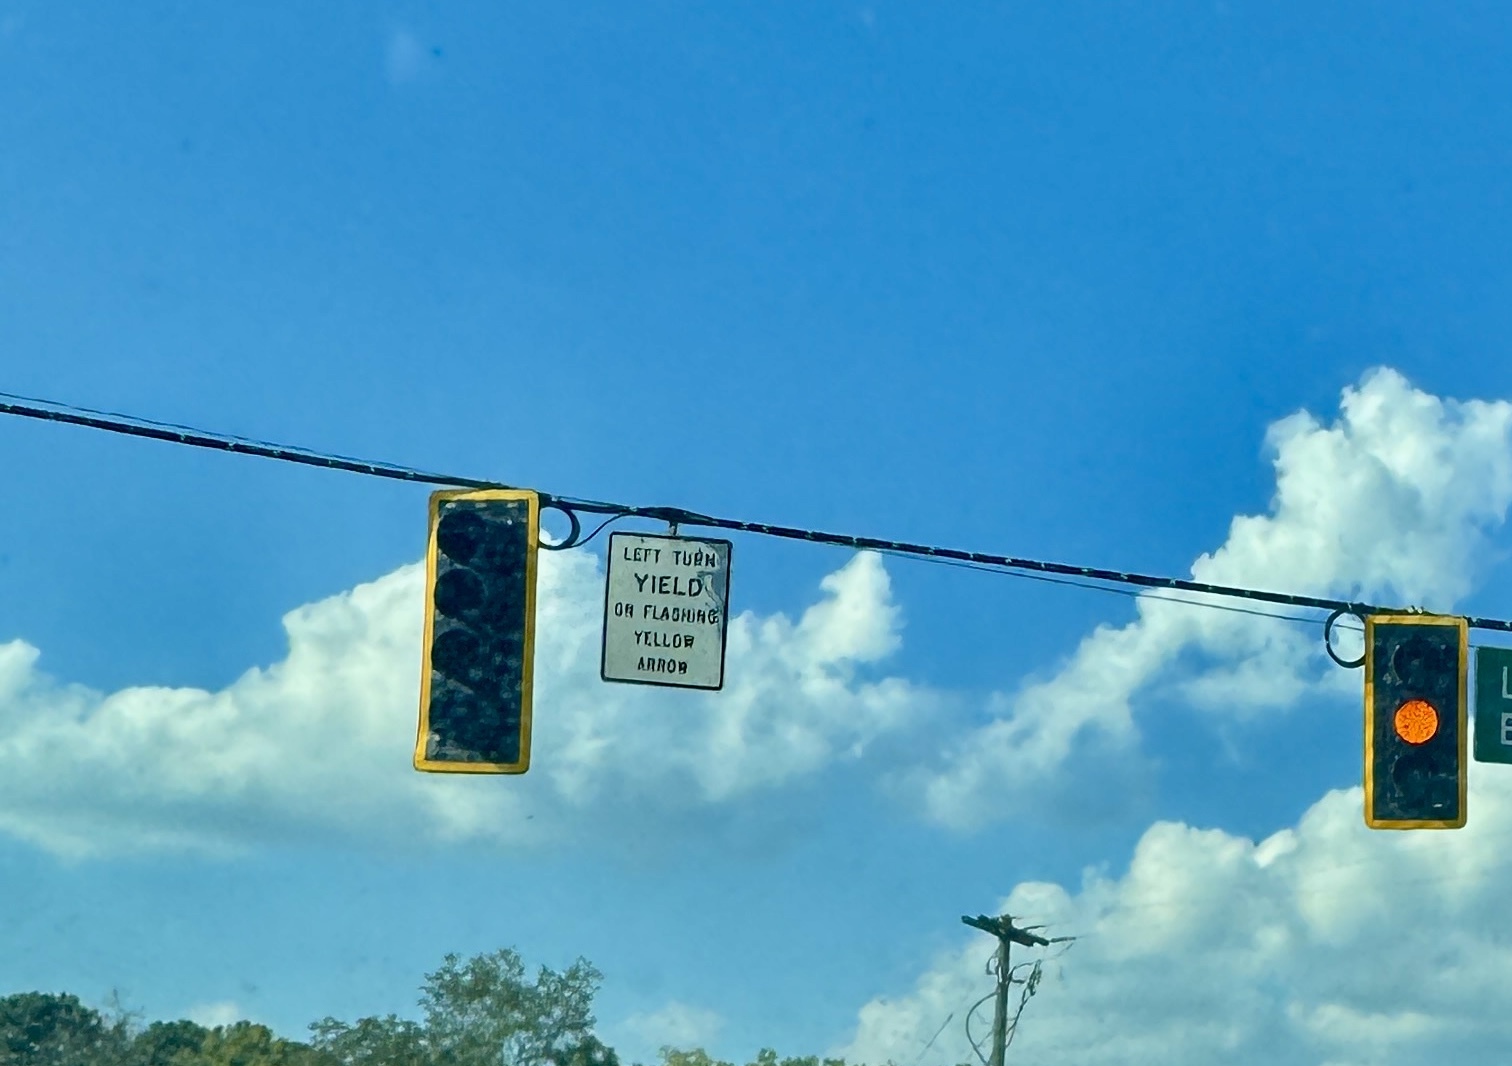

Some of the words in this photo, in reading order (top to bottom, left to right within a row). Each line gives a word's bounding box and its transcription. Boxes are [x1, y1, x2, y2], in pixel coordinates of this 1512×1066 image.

[624, 547, 661, 564] LEFT
[674, 549, 717, 568] TURN
[634, 573, 703, 597] YIELD
[614, 602, 634, 618] ON
[643, 604, 720, 625] FLASHING
[634, 630, 695, 649] YELLOW
[637, 656, 688, 674] ARROW
